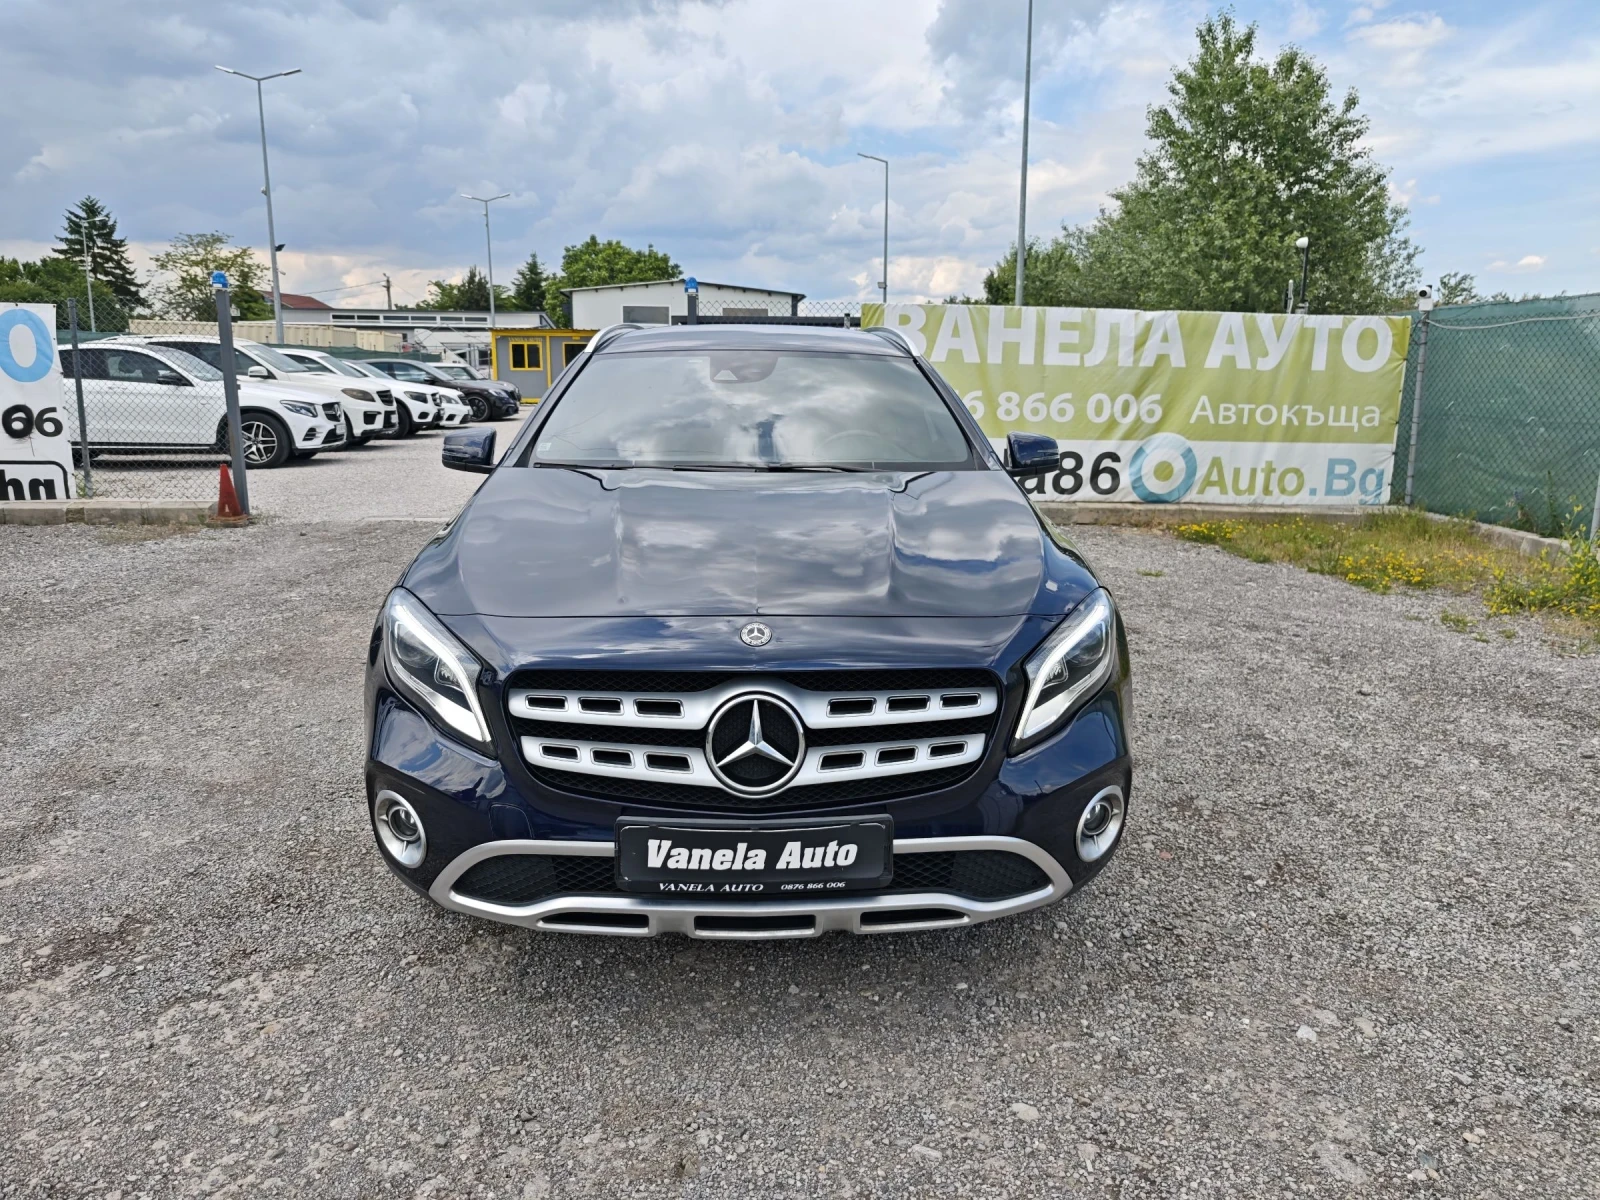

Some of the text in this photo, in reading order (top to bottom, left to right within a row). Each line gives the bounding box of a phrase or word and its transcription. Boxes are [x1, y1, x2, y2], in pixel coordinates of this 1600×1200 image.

[1204, 314, 1394, 373] АУТО
[996, 391, 1075, 423] 866
[1087, 393, 1163, 424] 006
[1190, 395, 1381, 432] Автокъща
[1196, 456, 1386, 505] Auto.Bg
[647, 839, 858, 870] Vanela Auto
[659, 882, 715, 892] VANELA
[720, 883, 764, 892] AUTO
